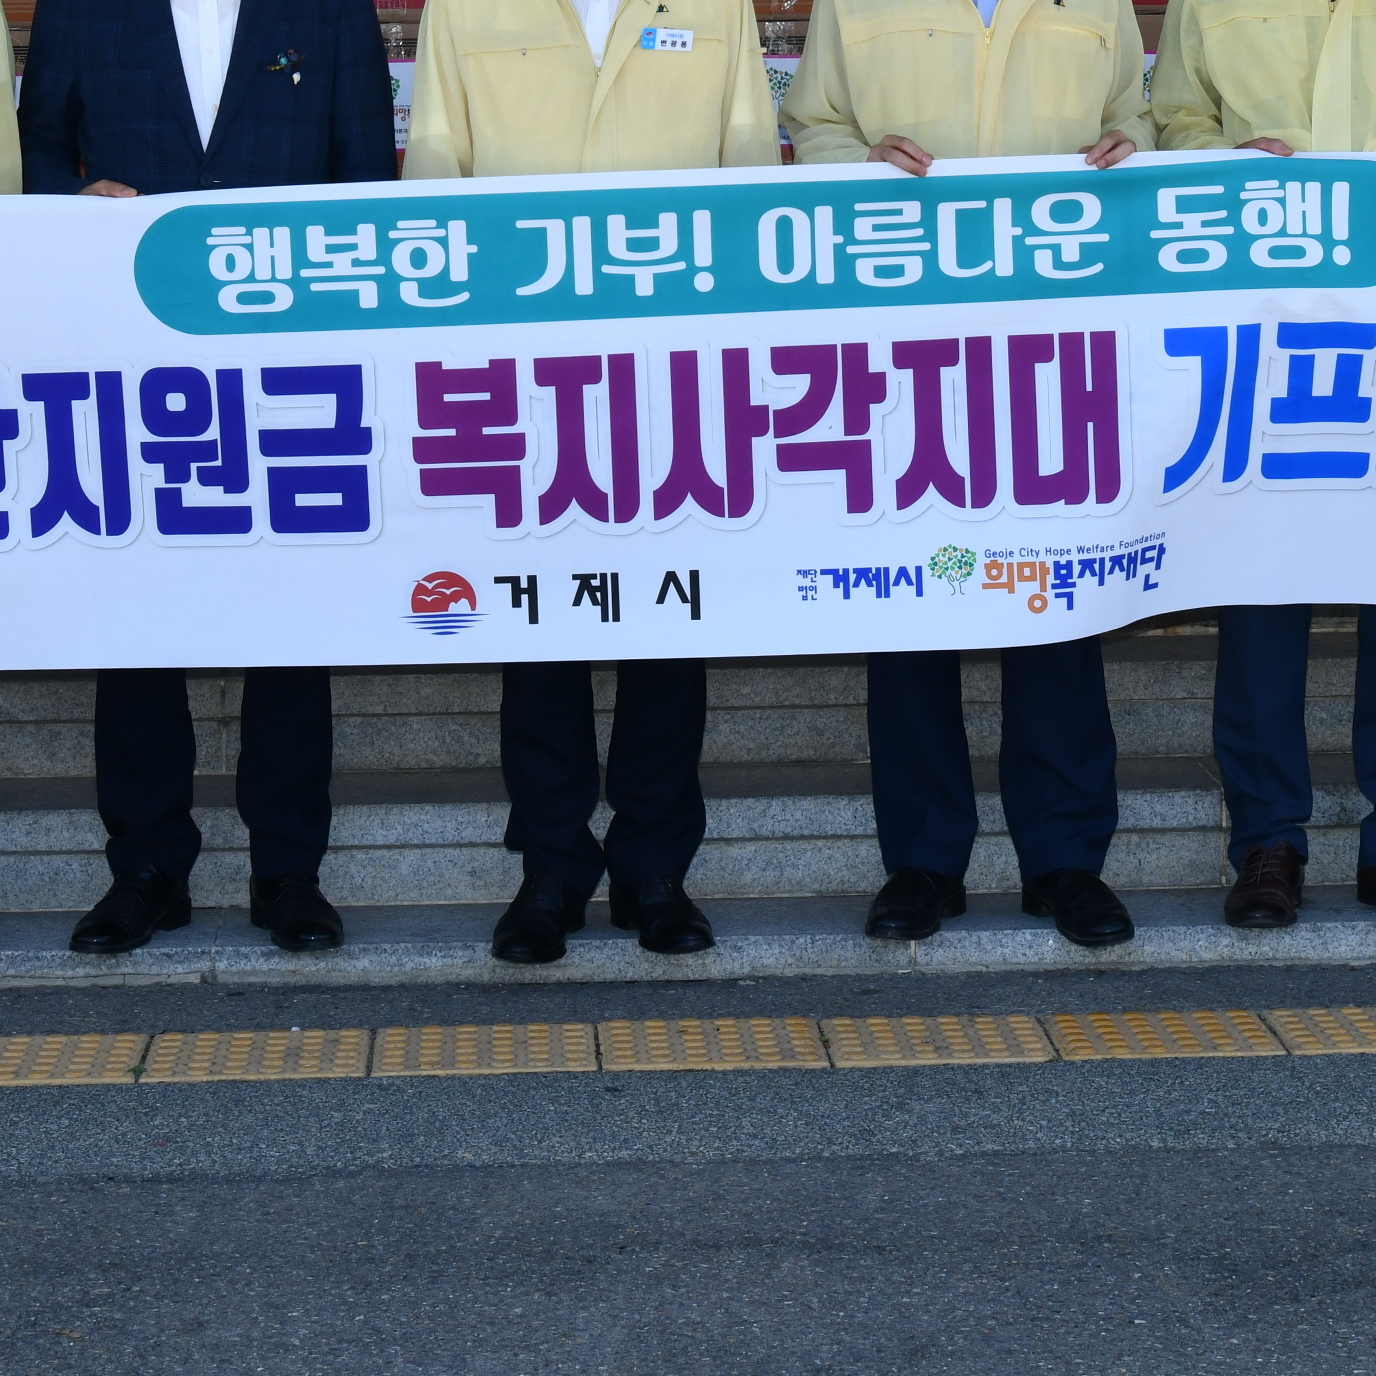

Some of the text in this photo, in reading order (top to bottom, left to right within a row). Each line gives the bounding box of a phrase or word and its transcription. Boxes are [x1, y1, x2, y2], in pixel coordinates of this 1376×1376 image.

[661, 40, 687, 49] 변광용
[206, 180, 1352, 314] 행복한 기부! 아름다운 동행!
[411, 330, 1123, 529] 복지사각지대
[984, 531, 1166, 560] Geoje City Hope Welfare Foundation
[796, 569, 818, 581] 재단
[797, 584, 818, 601] 법인
[819, 541, 1166, 614] 거제시 희망복지재단
[494, 569, 701, 624] 거제시
